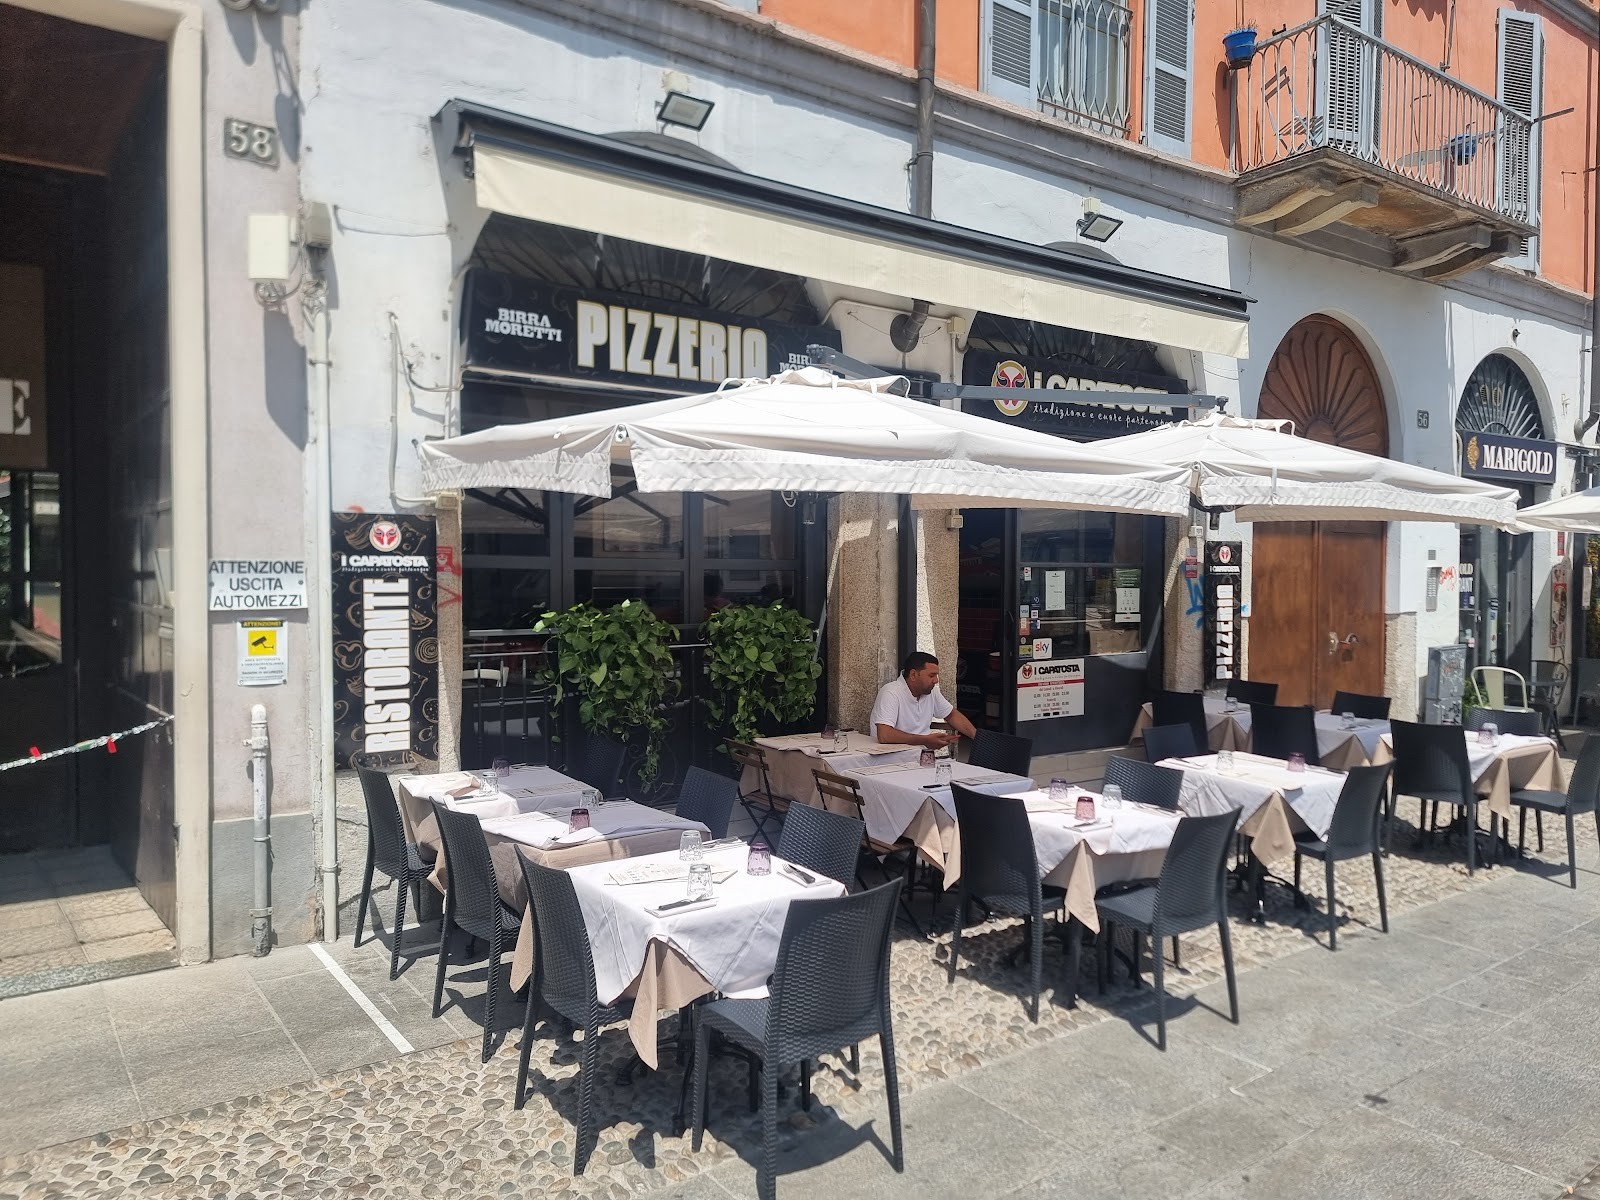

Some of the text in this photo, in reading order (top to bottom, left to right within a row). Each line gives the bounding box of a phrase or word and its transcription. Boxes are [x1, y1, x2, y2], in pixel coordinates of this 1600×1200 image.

[231, 122, 273, 159] 58
[497, 307, 552, 329] BIRRA
[484, 317, 563, 343] MORETTI
[1032, 402, 1087, 420] tradizione
[1089, 411, 1096, 419] e
[1097, 413, 1123, 424] cuore
[1417, 412, 1429, 428] 56
[1482, 444, 1554, 475] MARIGOLD
[208, 560, 305, 575] ATTENZIONE
[348, 554, 429, 567] CAPATOSTA
[229, 578, 284, 591] USCITA
[213, 594, 303, 608] AUTOMEZZI
[1216, 585, 1233, 679] PIZZERIA
[1036, 642, 1050, 653] sky
[363, 577, 412, 754] RISTORANTE
[1034, 664, 1081, 675] I CAPATOSTA
